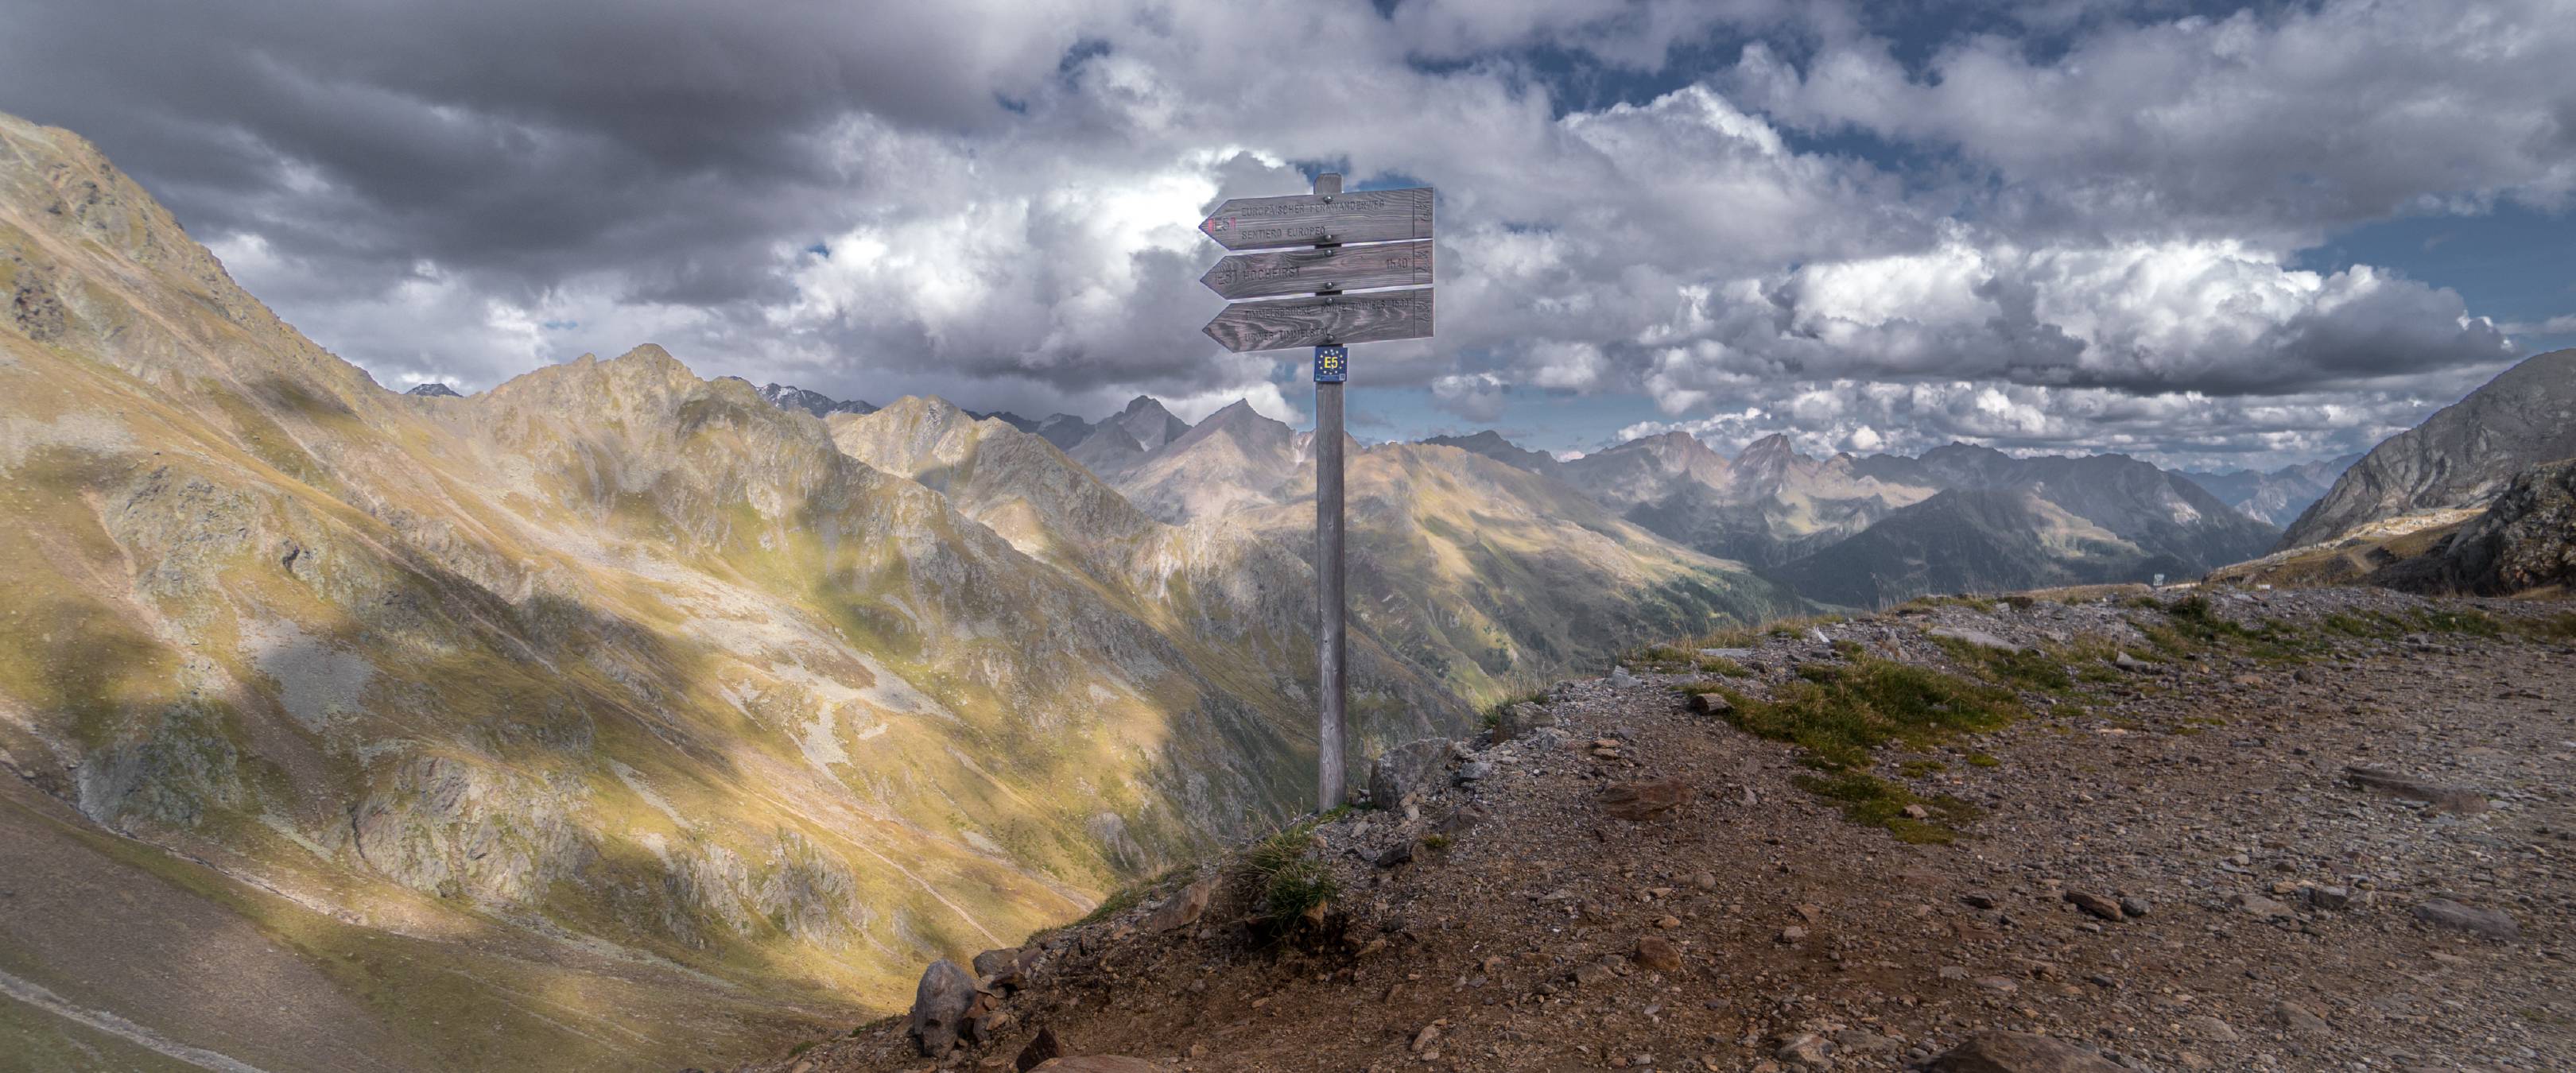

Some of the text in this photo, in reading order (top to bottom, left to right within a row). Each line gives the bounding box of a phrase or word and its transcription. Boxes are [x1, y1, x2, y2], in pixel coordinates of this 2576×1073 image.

[1310, 199, 1385, 214] FERNWANDERWEG
[1242, 226, 1326, 240] SENTIERO EUROPEO
[1243, 266, 1301, 281] HOCHFIRST
[1279, 327, 1330, 340] TIMMELSTAL
[1324, 356, 1338, 369] E5
